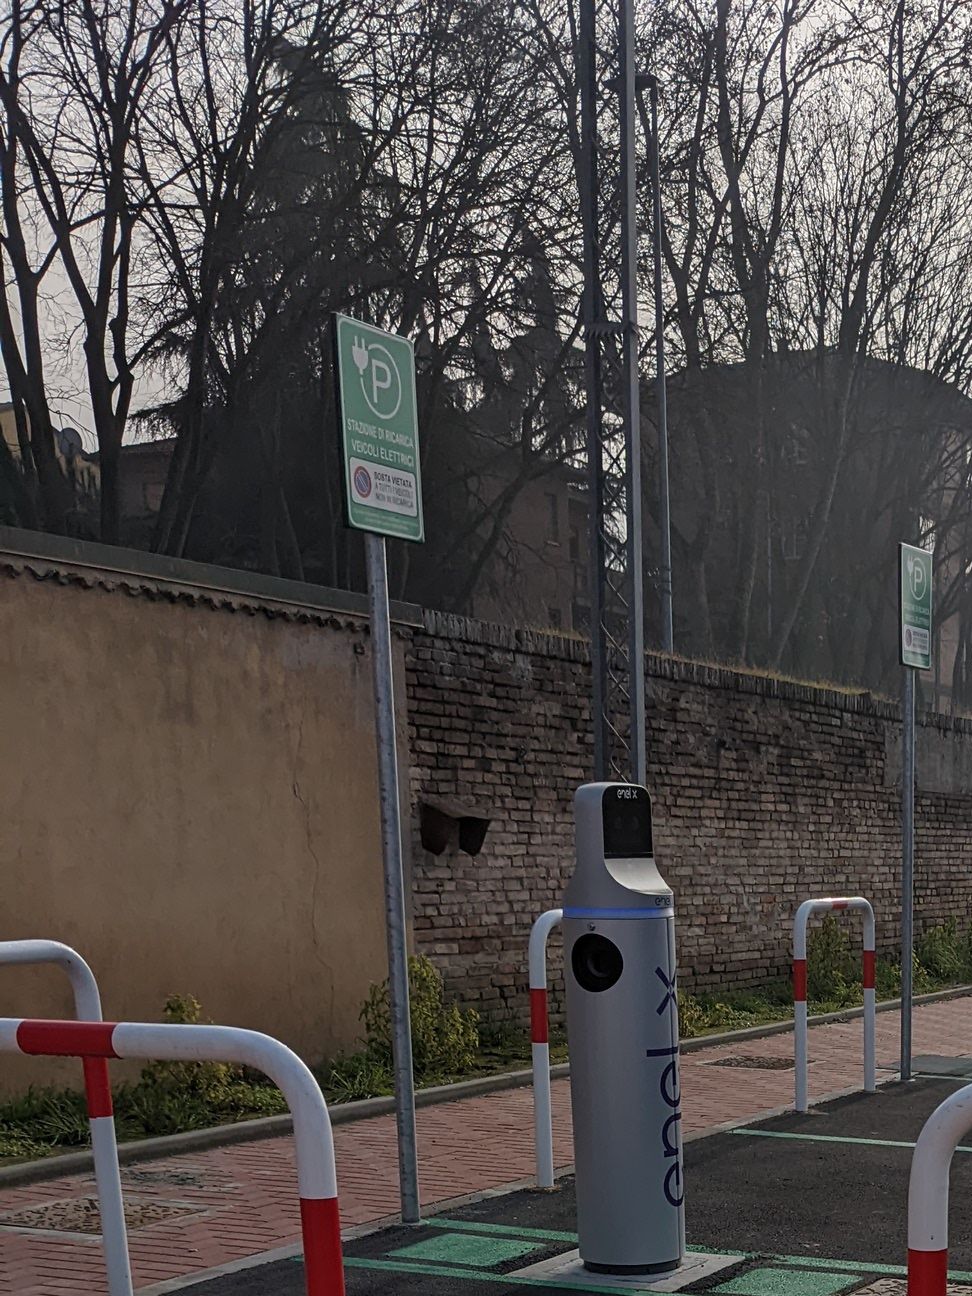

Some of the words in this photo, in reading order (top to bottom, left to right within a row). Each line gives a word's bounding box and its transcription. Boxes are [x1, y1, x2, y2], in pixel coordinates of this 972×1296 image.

[371, 358, 391, 403] P
[347, 418, 377, 439] STAZIONE
[378, 427, 384, 440] DI
[385, 430, 414, 448] RICARICA
[351, 439, 379, 458] VEICOLI
[380, 447, 414, 468] ELETTRICI
[374, 471, 391, 483] SOSTA
[391, 476, 412, 488] VIETATA
[914, 567, 923, 592] P
[617, 788, 631, 799] enel
[632, 790, 638, 799] x
[655, 965, 677, 1016] x
[646, 1046, 684, 1208] enel
